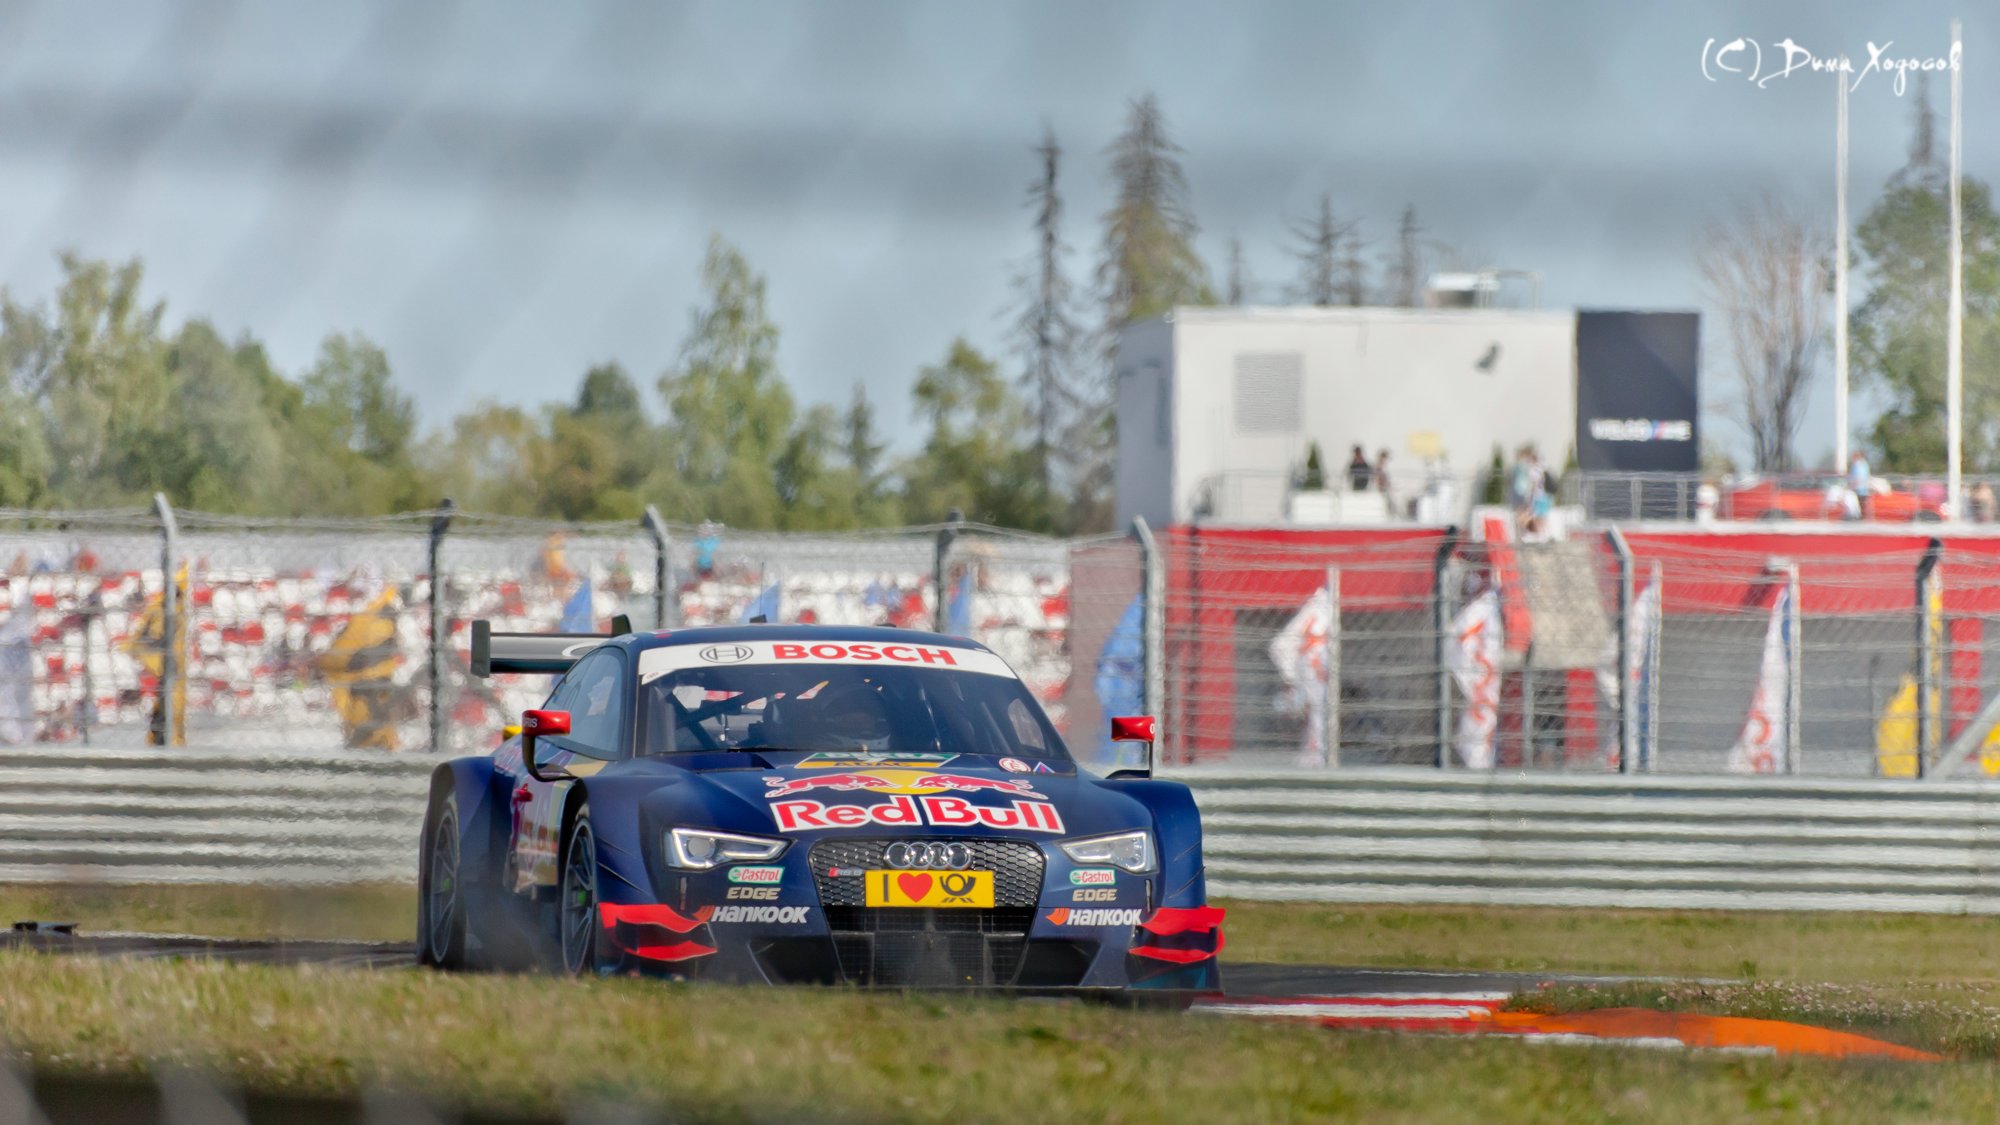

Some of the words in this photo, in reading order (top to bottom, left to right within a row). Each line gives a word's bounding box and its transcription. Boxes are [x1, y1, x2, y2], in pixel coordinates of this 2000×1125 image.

[773, 644, 957, 665] BOSCH
[771, 796, 921, 831] Red
[921, 797, 1064, 833] Bull
[741, 868, 779, 881] Castrol
[1082, 871, 1113, 883] Castrol
[726, 887, 781, 900] EDGE
[1072, 889, 1117, 902] EDGE
